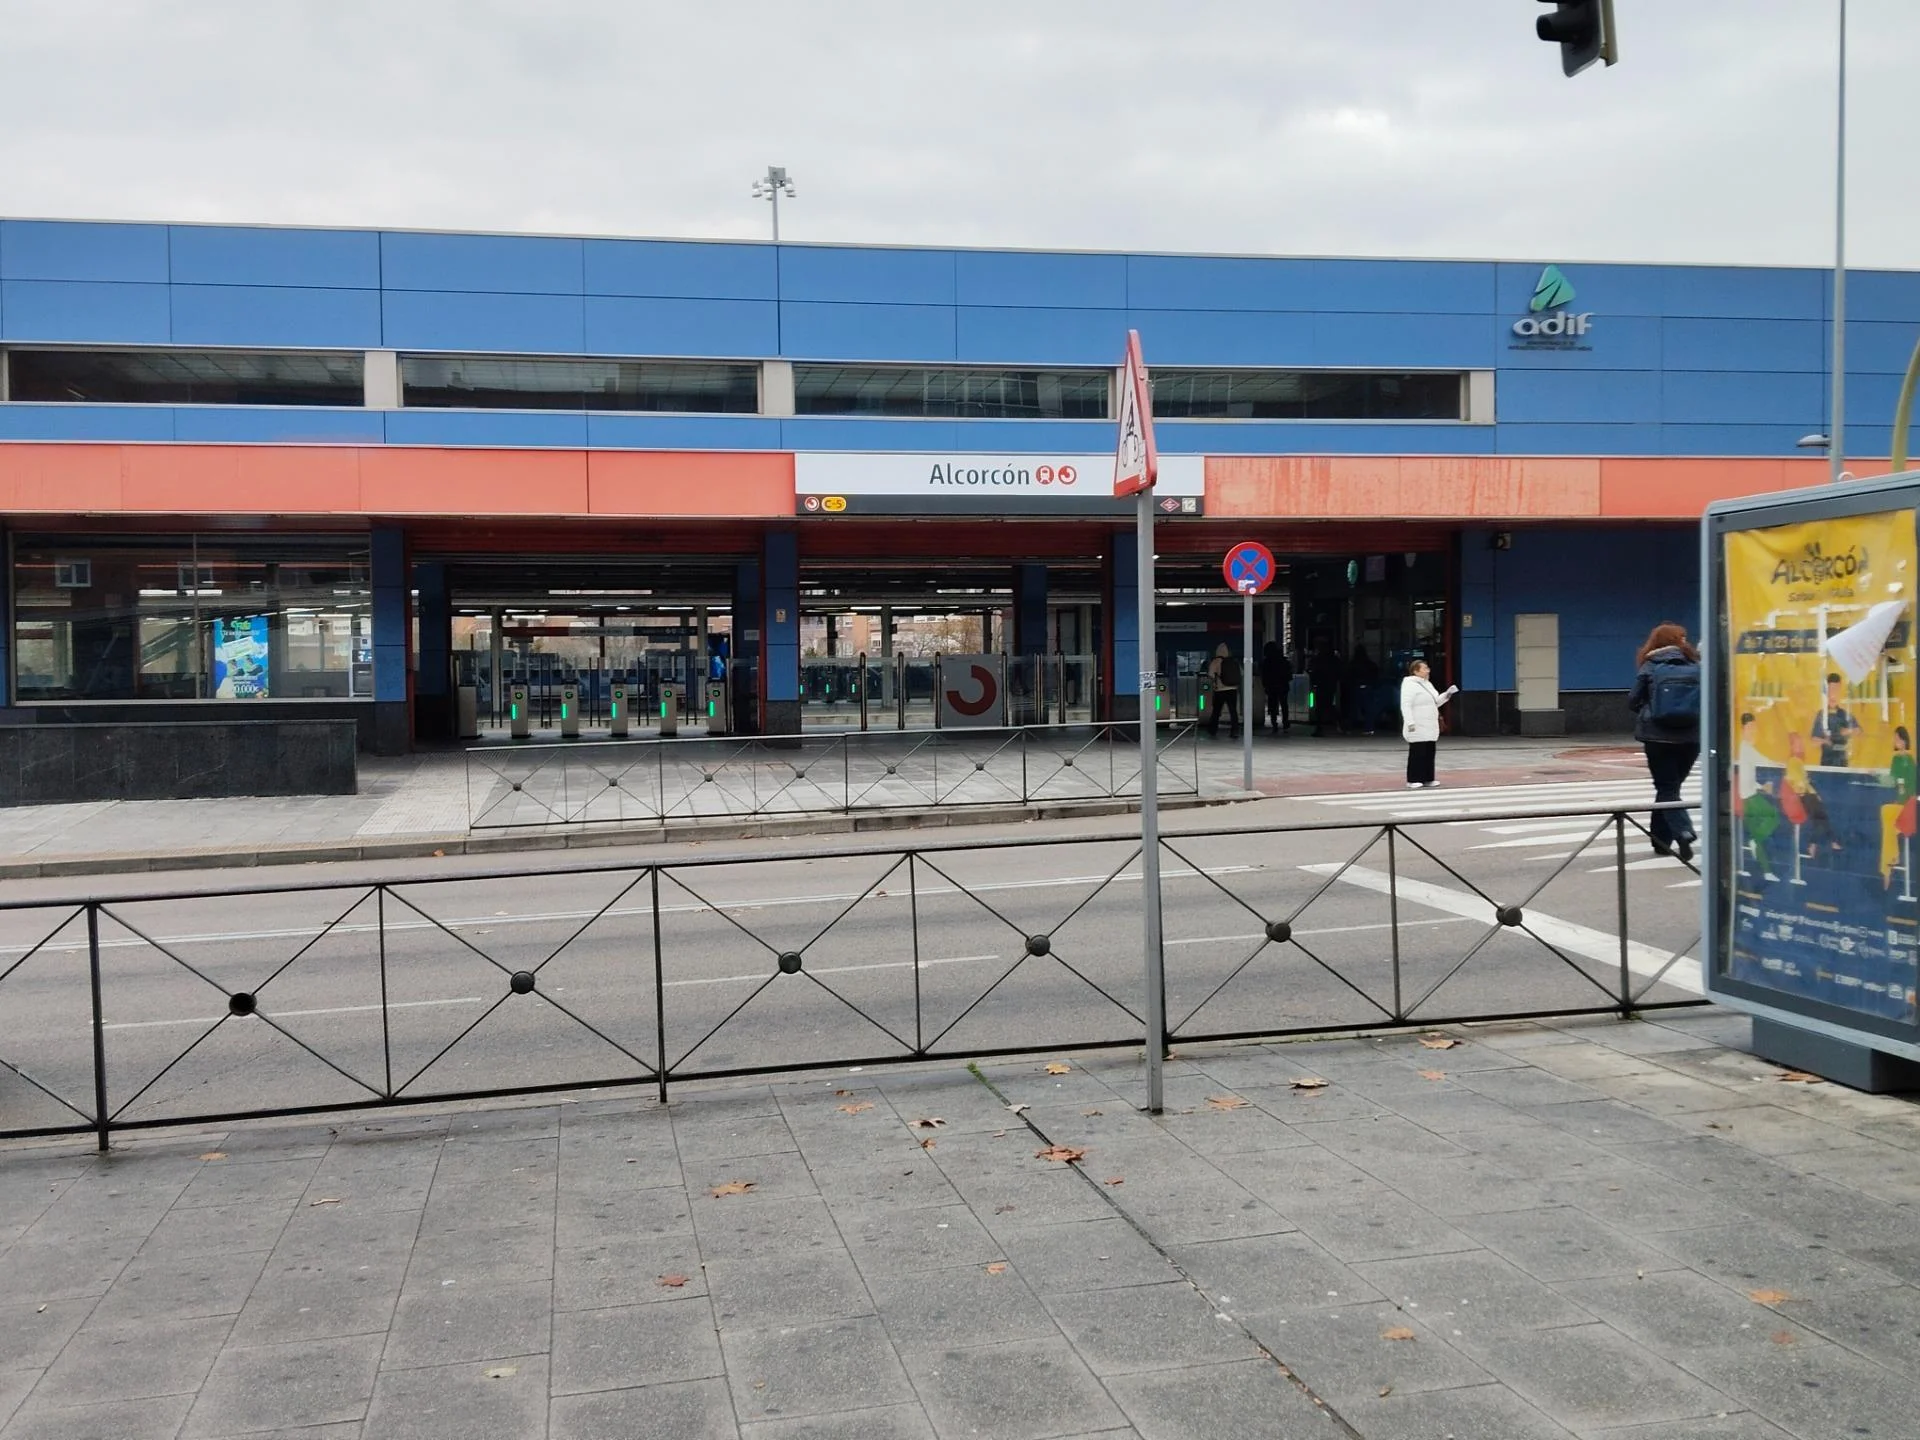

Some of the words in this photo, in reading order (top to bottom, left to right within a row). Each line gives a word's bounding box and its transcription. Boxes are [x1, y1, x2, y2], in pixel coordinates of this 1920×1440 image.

[1512, 311, 1595, 336] adif
[929, 463, 1030, 485] Alcorcón
[1182, 499, 1196, 511] 12
